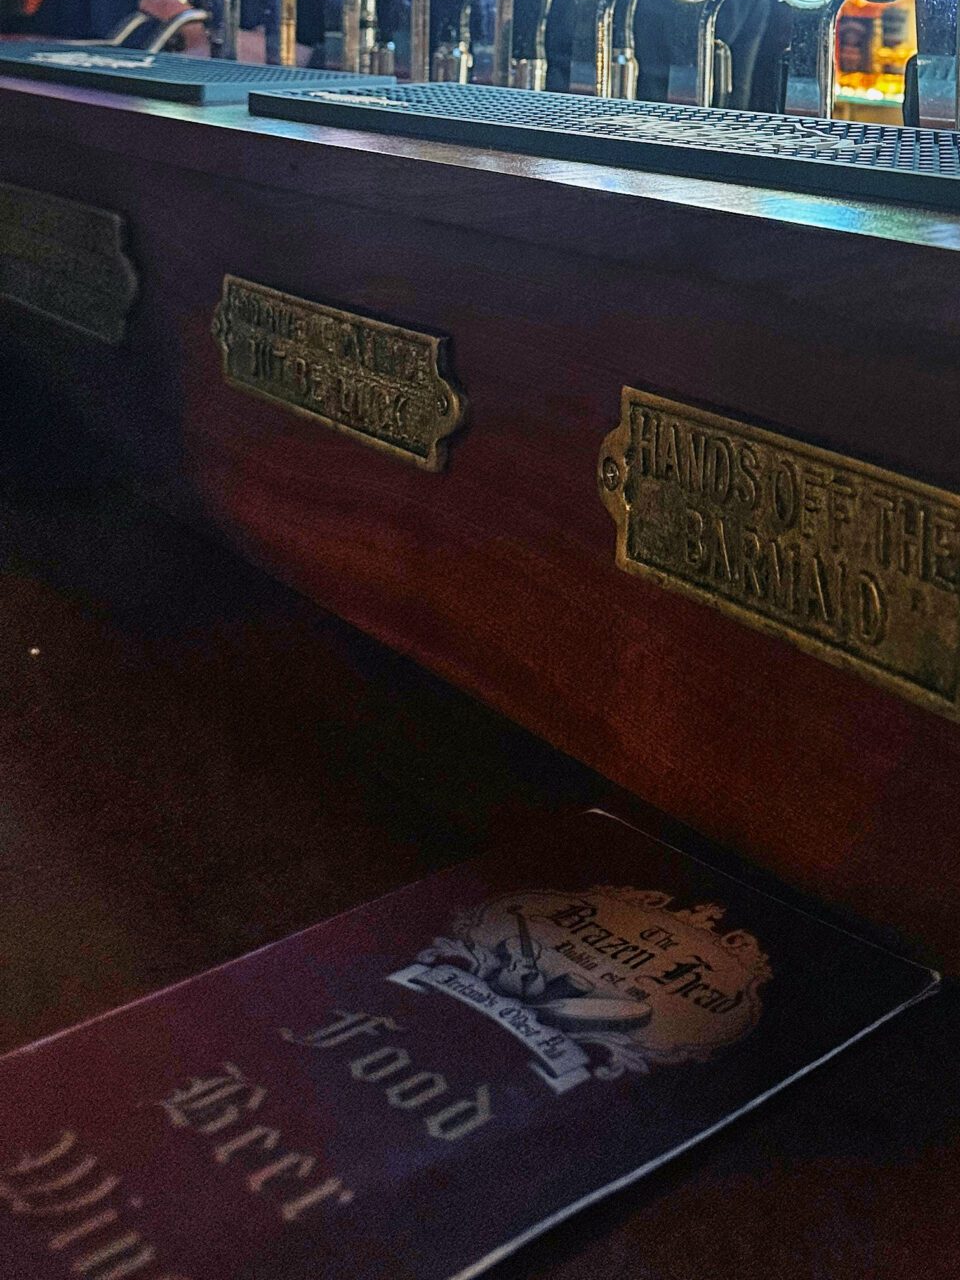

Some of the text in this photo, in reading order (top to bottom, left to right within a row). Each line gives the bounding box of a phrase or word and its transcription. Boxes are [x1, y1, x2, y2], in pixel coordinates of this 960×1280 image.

[634, 410, 762, 512] HANDS
[771, 457, 856, 556] OFF
[685, 508, 889, 647] BARMAID
[438, 971, 498, 1009] Ireland's
[499, 1004, 541, 1038] Oldest
[552, 900, 745, 1015] Brazen Head
[554, 941, 599, 972] Dublin
[638, 925, 678, 951] The
[160, 1061, 355, 1220] Beer
[278, 1009, 496, 1142] Food
[0, 1130, 170, 1280] Win
